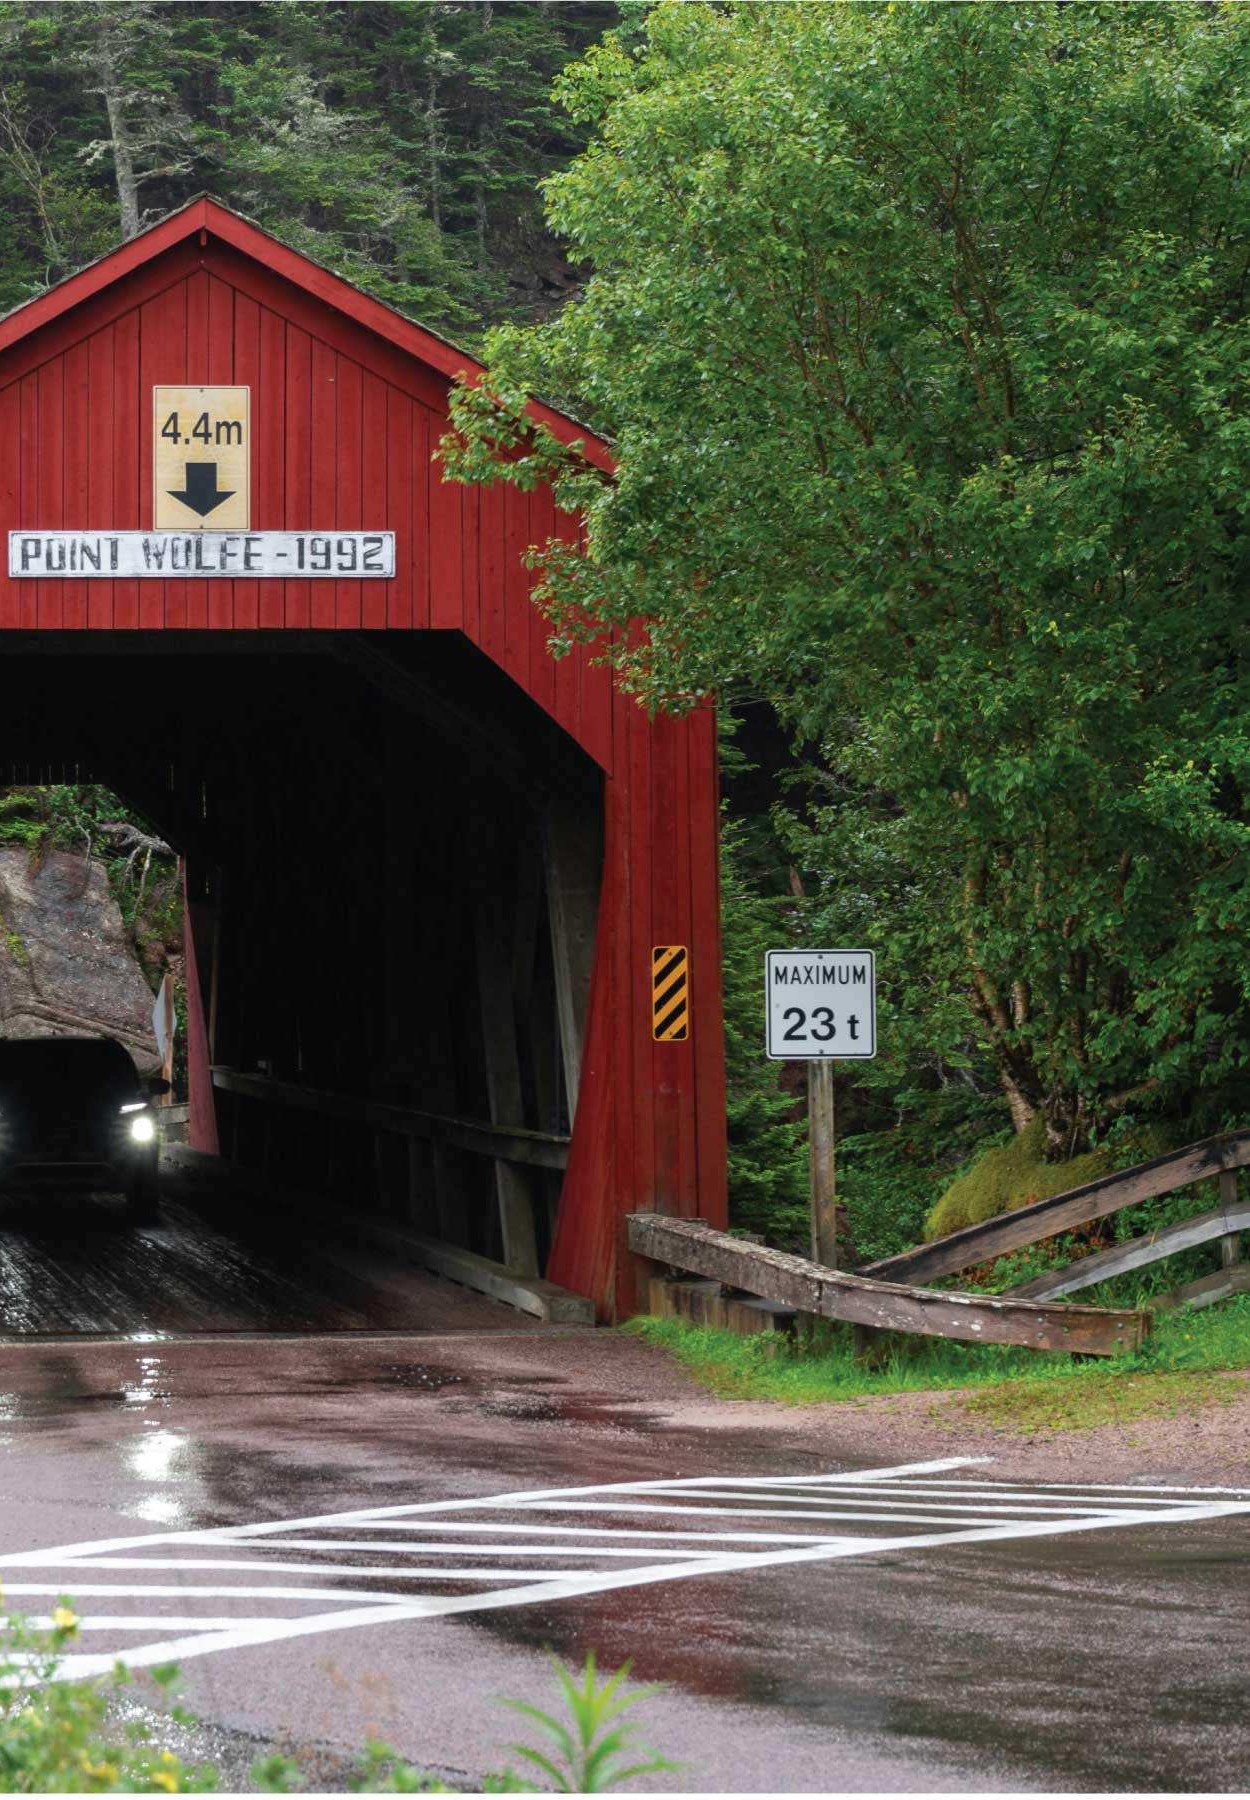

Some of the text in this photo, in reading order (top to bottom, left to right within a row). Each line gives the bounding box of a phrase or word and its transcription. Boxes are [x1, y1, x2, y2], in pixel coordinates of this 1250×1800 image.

[161, 412, 243, 445] 4.4m
[21, 537, 120, 571] POINT
[142, 537, 264, 571] WOLFE
[774, 965, 866, 985] MAXIMUM
[782, 1007, 860, 1042] 23 t
